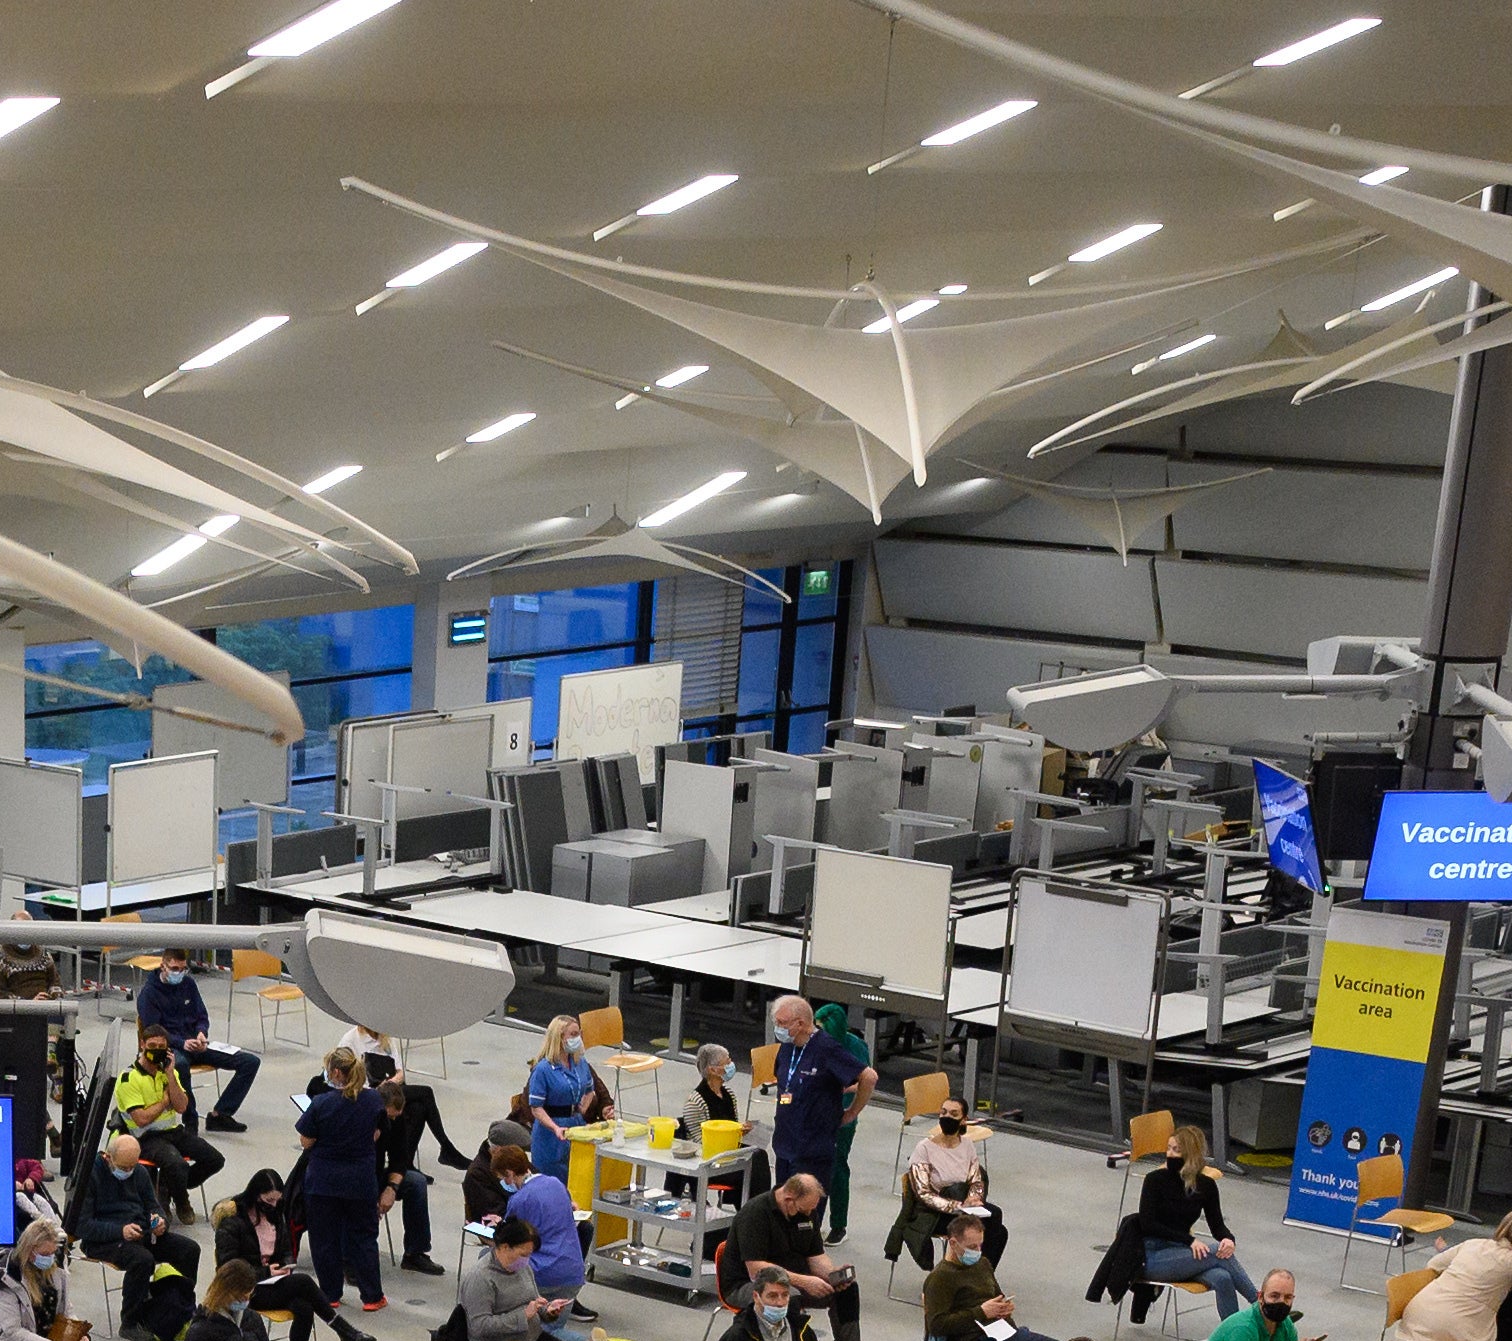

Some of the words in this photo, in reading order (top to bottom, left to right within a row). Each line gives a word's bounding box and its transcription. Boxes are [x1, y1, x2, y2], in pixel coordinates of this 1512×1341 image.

[565, 682, 678, 739] Moderna
[509, 732, 519, 751] 8
[1334, 974, 1426, 1001] Vaccination
[1358, 1003, 1393, 1019] area
[1301, 1168, 1336, 1186] Thank
